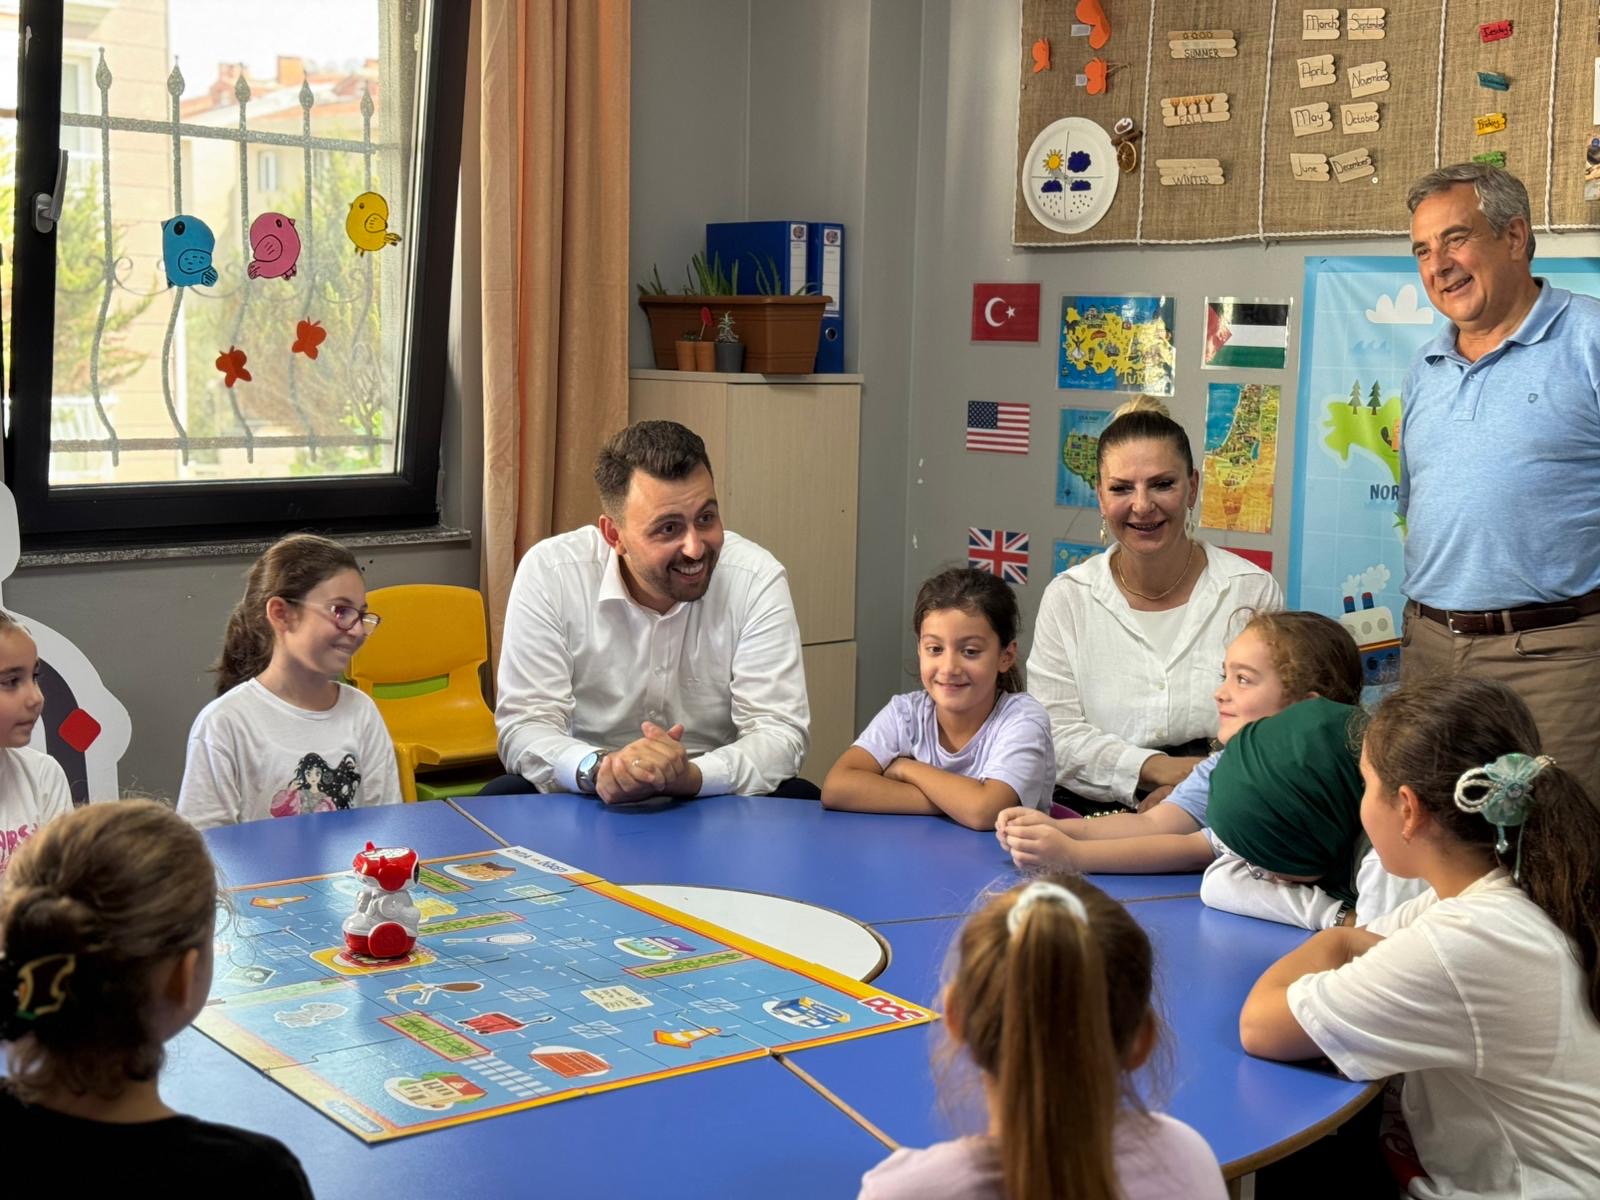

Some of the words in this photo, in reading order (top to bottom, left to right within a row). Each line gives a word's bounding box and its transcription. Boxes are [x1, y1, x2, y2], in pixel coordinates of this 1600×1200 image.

[1306, 14, 1338, 32] March
[1184, 48, 1219, 58] SUMMER
[1300, 60, 1328, 81] April
[1351, 69, 1389, 89] November
[1294, 108, 1324, 128] May
[1345, 109, 1378, 126] October
[1296, 156, 1318, 177] June
[1332, 157, 1369, 174] December
[1172, 175, 1209, 186] WINTER
[1370, 484, 1399, 500] NOR
[859, 996, 926, 1021] DOC
